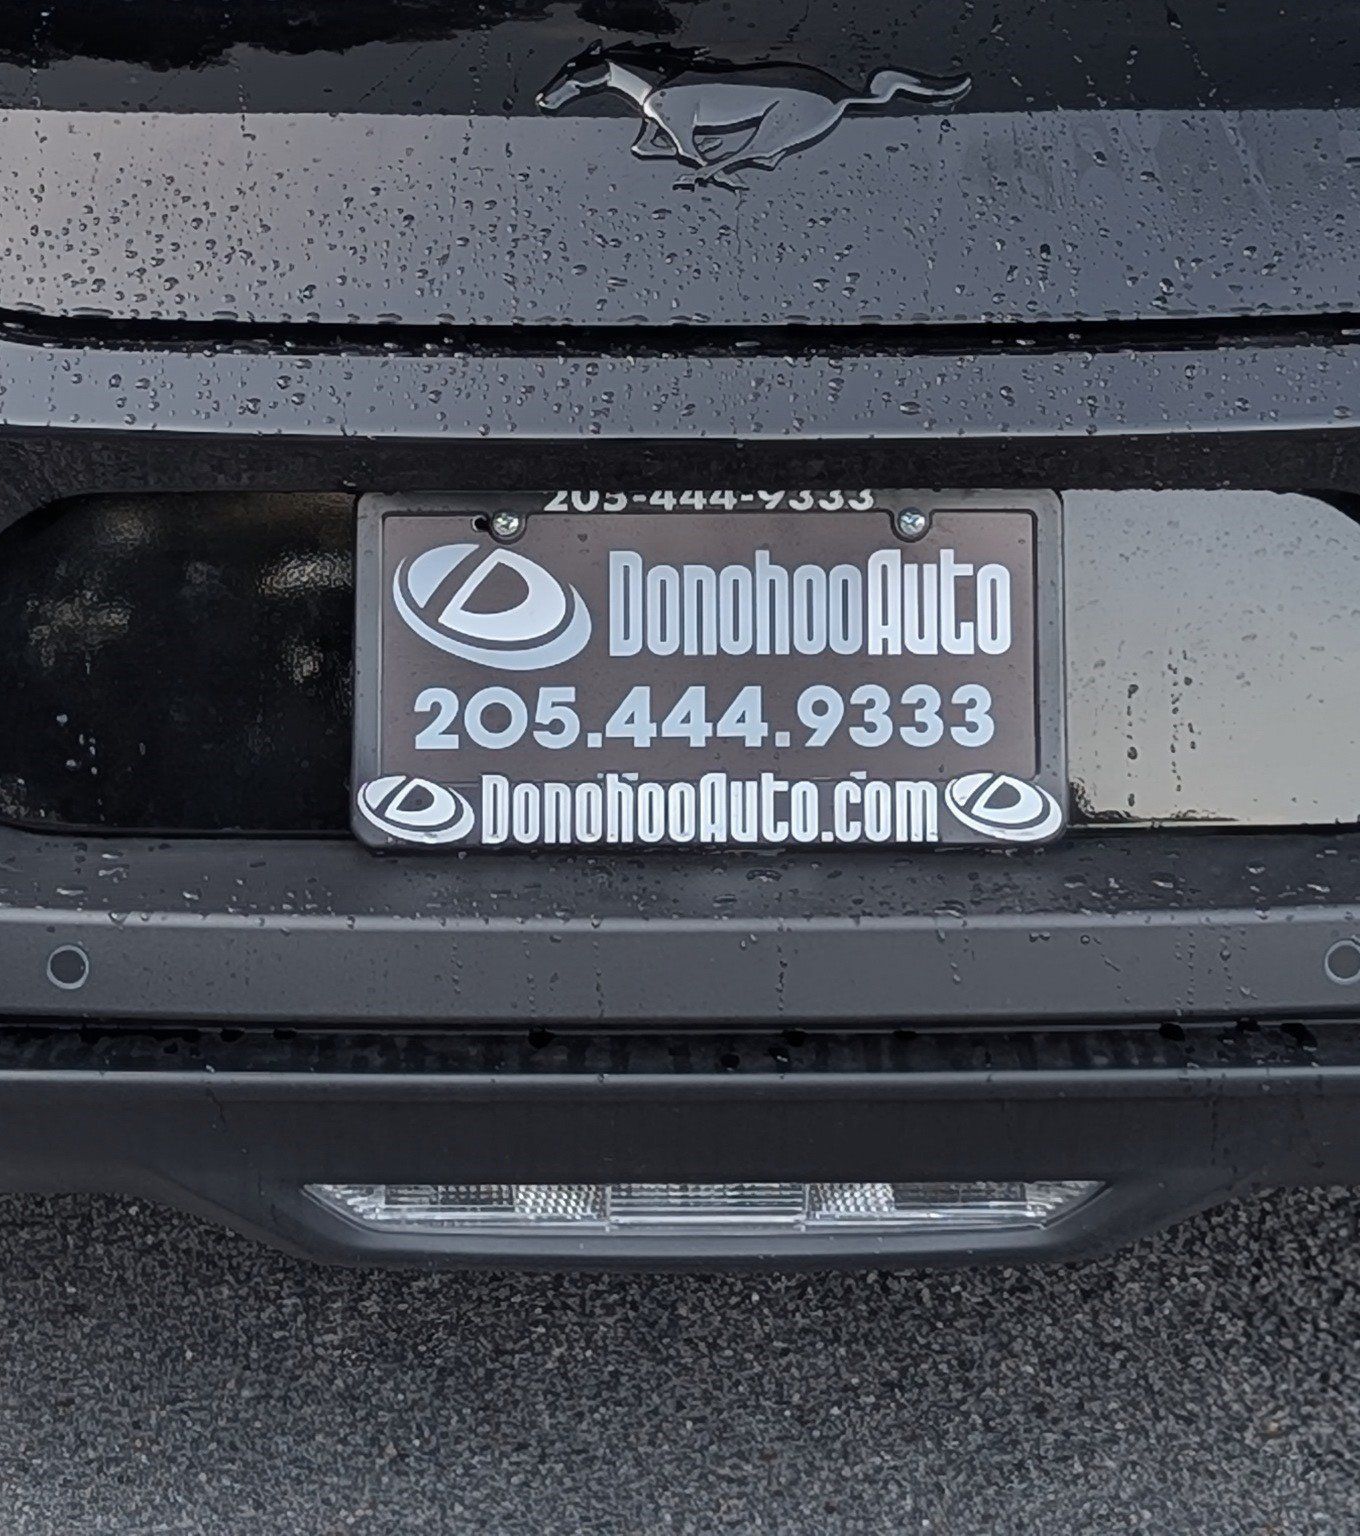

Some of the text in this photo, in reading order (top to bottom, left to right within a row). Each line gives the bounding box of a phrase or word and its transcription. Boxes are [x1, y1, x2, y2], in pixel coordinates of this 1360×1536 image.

[608, 549, 1012, 657] DonohooAuto
[413, 683, 995, 750] 205.444.9333
[481, 772, 939, 844] DonohooAuto.com
